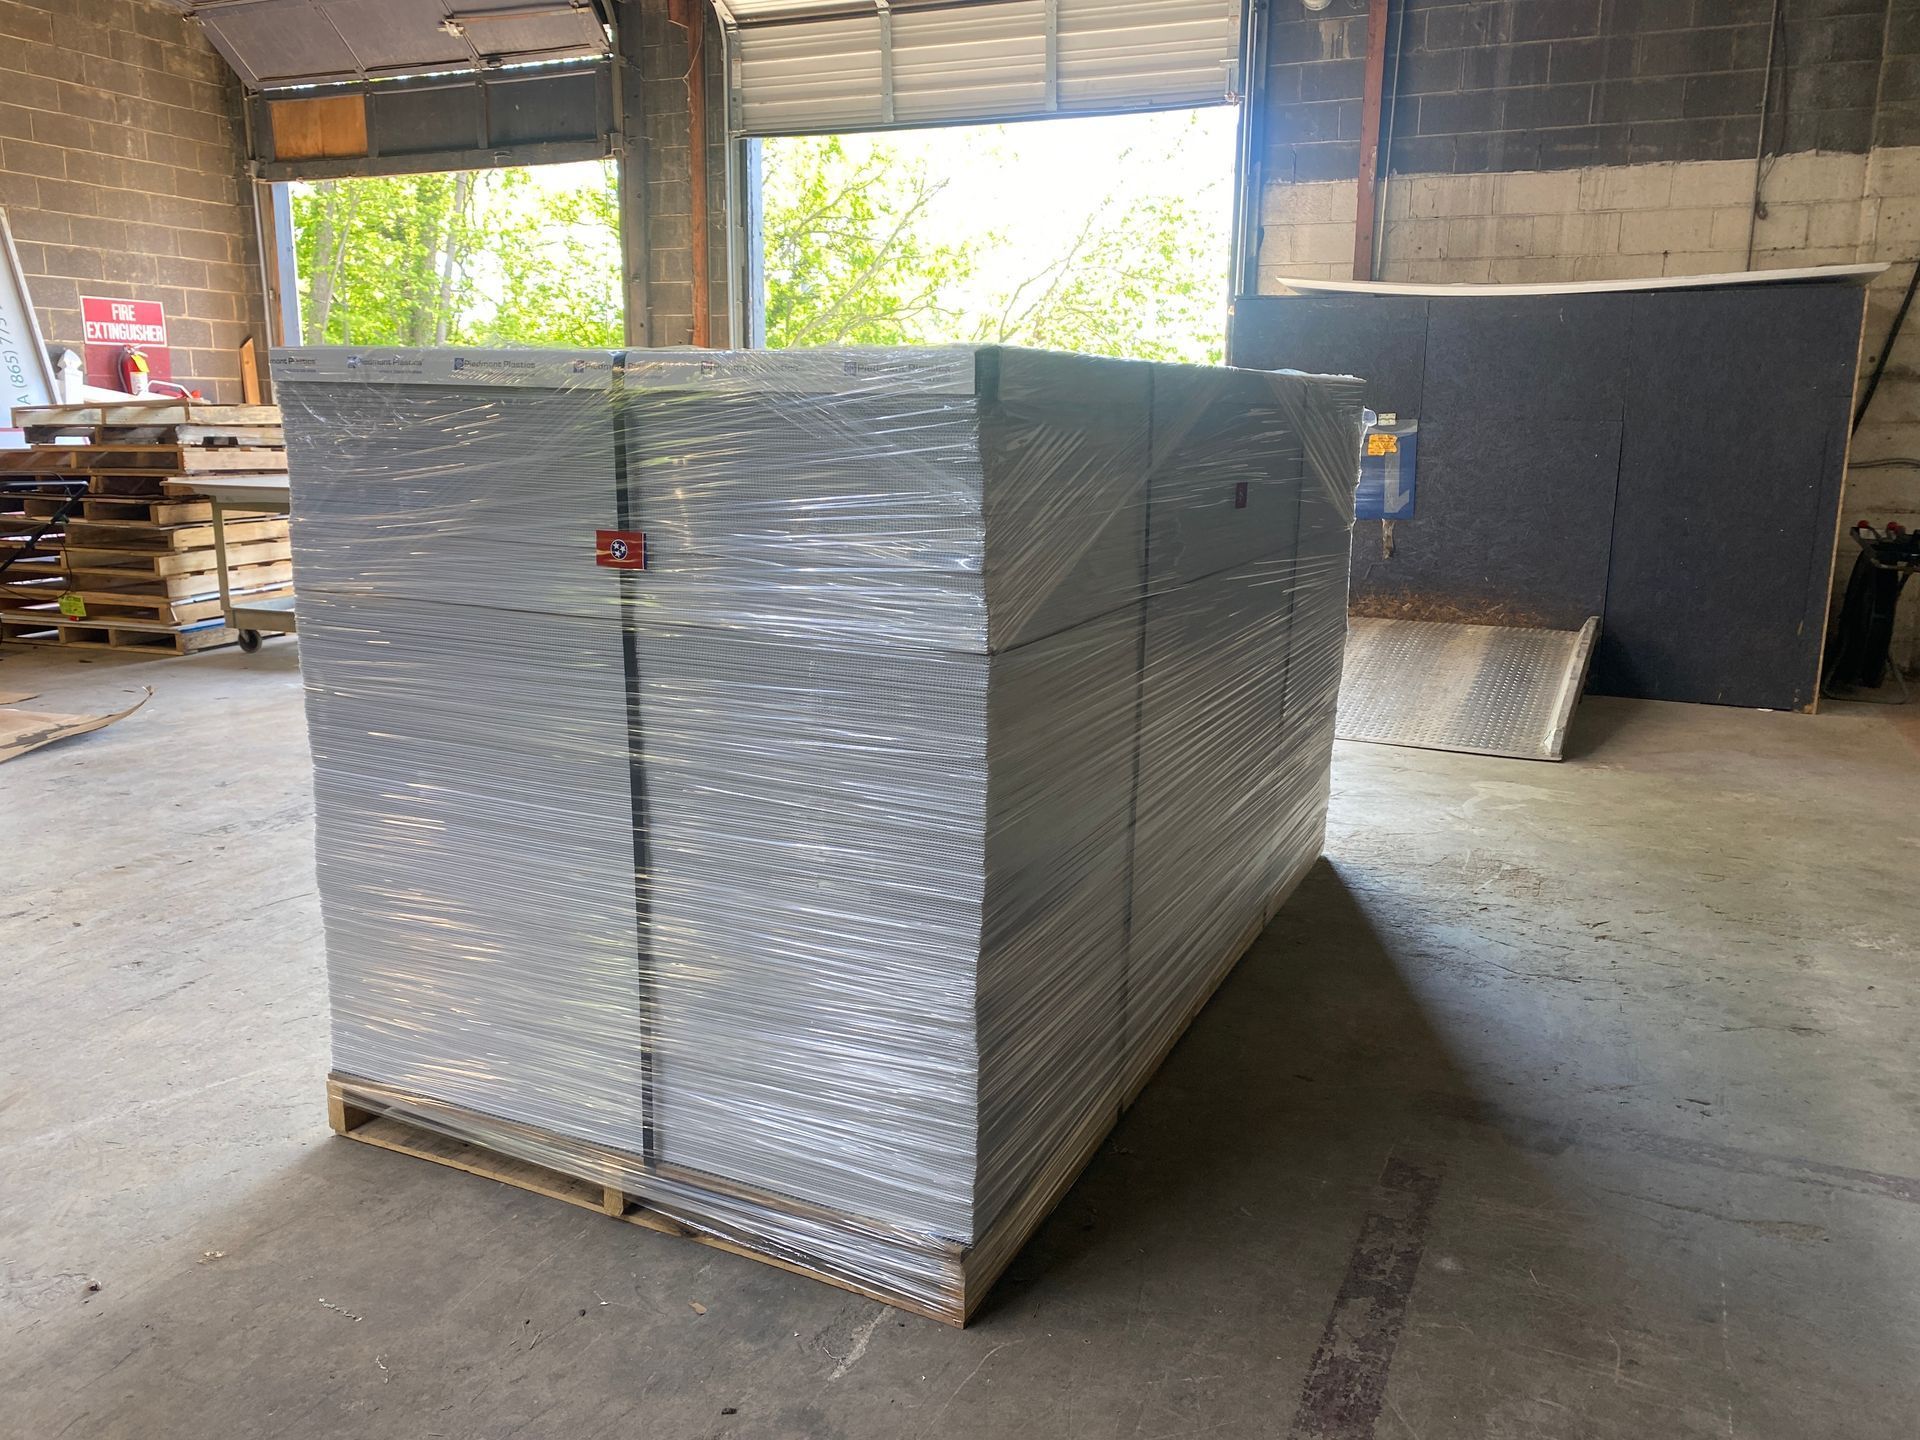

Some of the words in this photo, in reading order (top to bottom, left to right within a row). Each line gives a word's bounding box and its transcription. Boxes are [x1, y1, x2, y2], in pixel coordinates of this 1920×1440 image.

[111, 303, 136, 321] FIRE
[85, 321, 164, 342] EXTINGUISHER
[464, 359, 502, 368] Piedmont
[503, 360, 536, 369] Plastics
